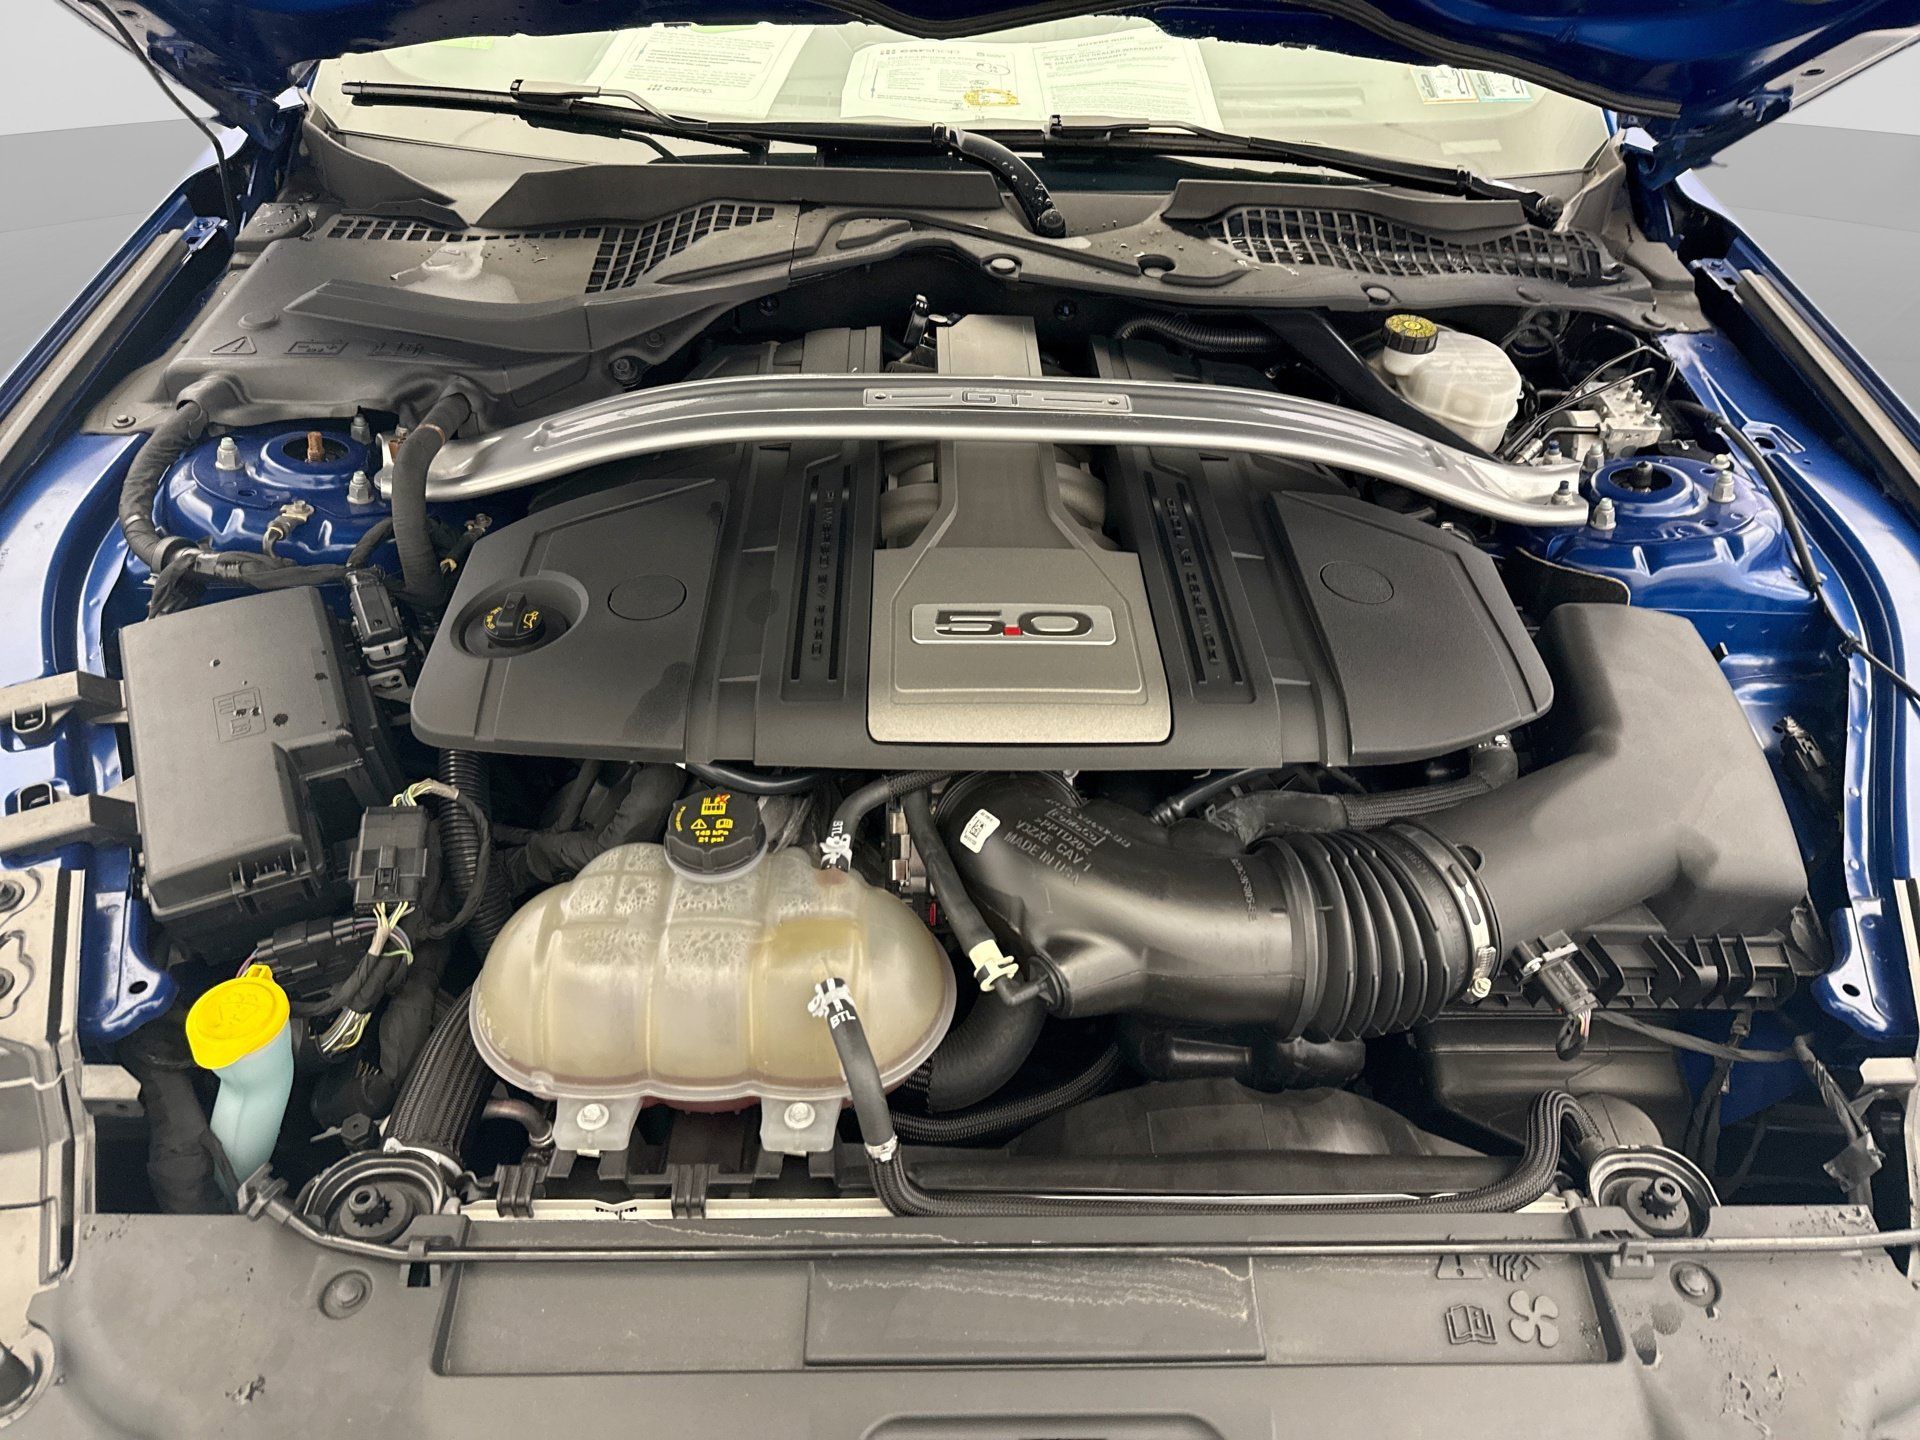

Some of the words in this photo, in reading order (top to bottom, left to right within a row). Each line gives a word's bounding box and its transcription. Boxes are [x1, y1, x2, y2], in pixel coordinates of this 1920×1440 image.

[664, 85, 713, 95] carshop
[962, 390, 1033, 406] GT
[934, 609, 1094, 637] 5.0
[1003, 831, 1040, 857] MADE
[1039, 850, 1055, 865] IN
[830, 1010, 856, 1029] BTL
